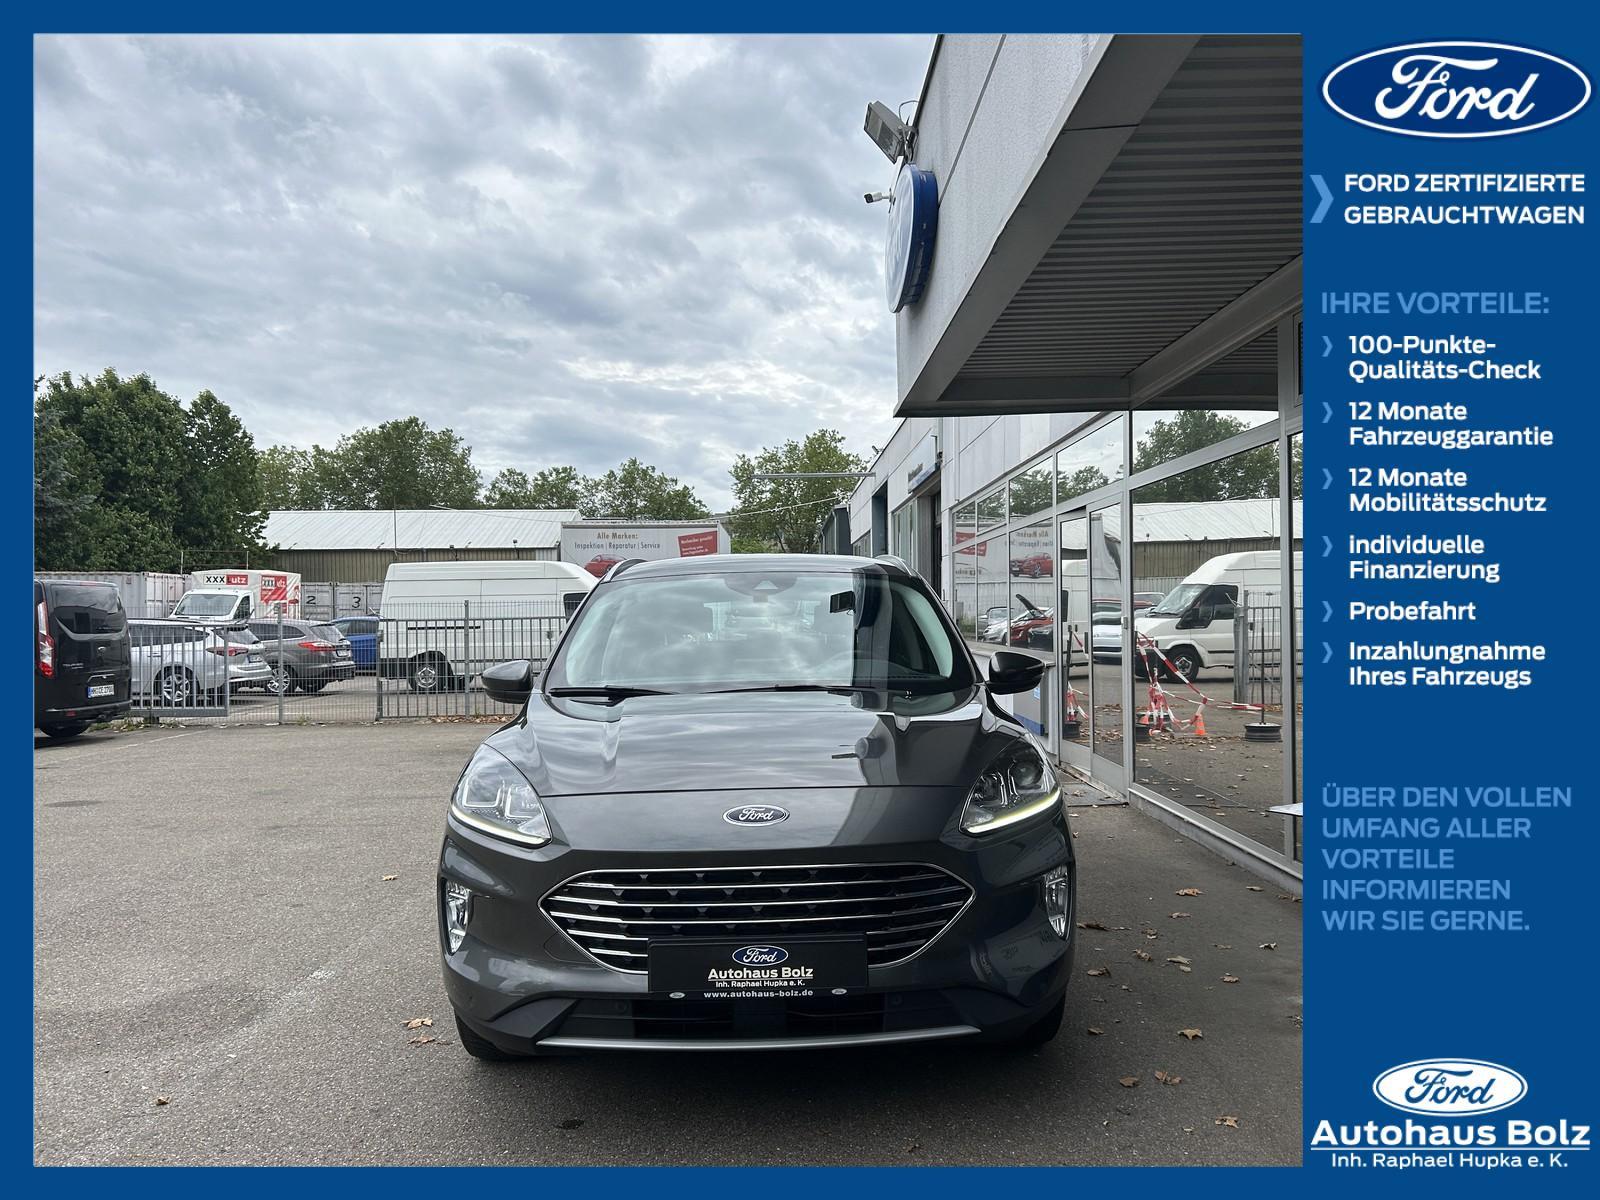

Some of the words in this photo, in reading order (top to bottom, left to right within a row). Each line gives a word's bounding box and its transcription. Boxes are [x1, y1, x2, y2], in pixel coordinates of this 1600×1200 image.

[597, 532, 609, 540] Alle
[612, 532, 639, 540] Marken:
[575, 542, 604, 550] Inspektion
[608, 542, 636, 550] Reparatur
[306, 596, 316, 605] 2
[352, 597, 362, 608] 3
[738, 807, 774, 821] Ford
[743, 948, 776, 963] Ford
[708, 968, 778, 979] Autohaus
[781, 966, 813, 978] Bolz
[731, 980, 762, 988] Raphael
[763, 980, 788, 988] Hupka
[704, 989, 813, 998] www.autohaus-bolz.de
